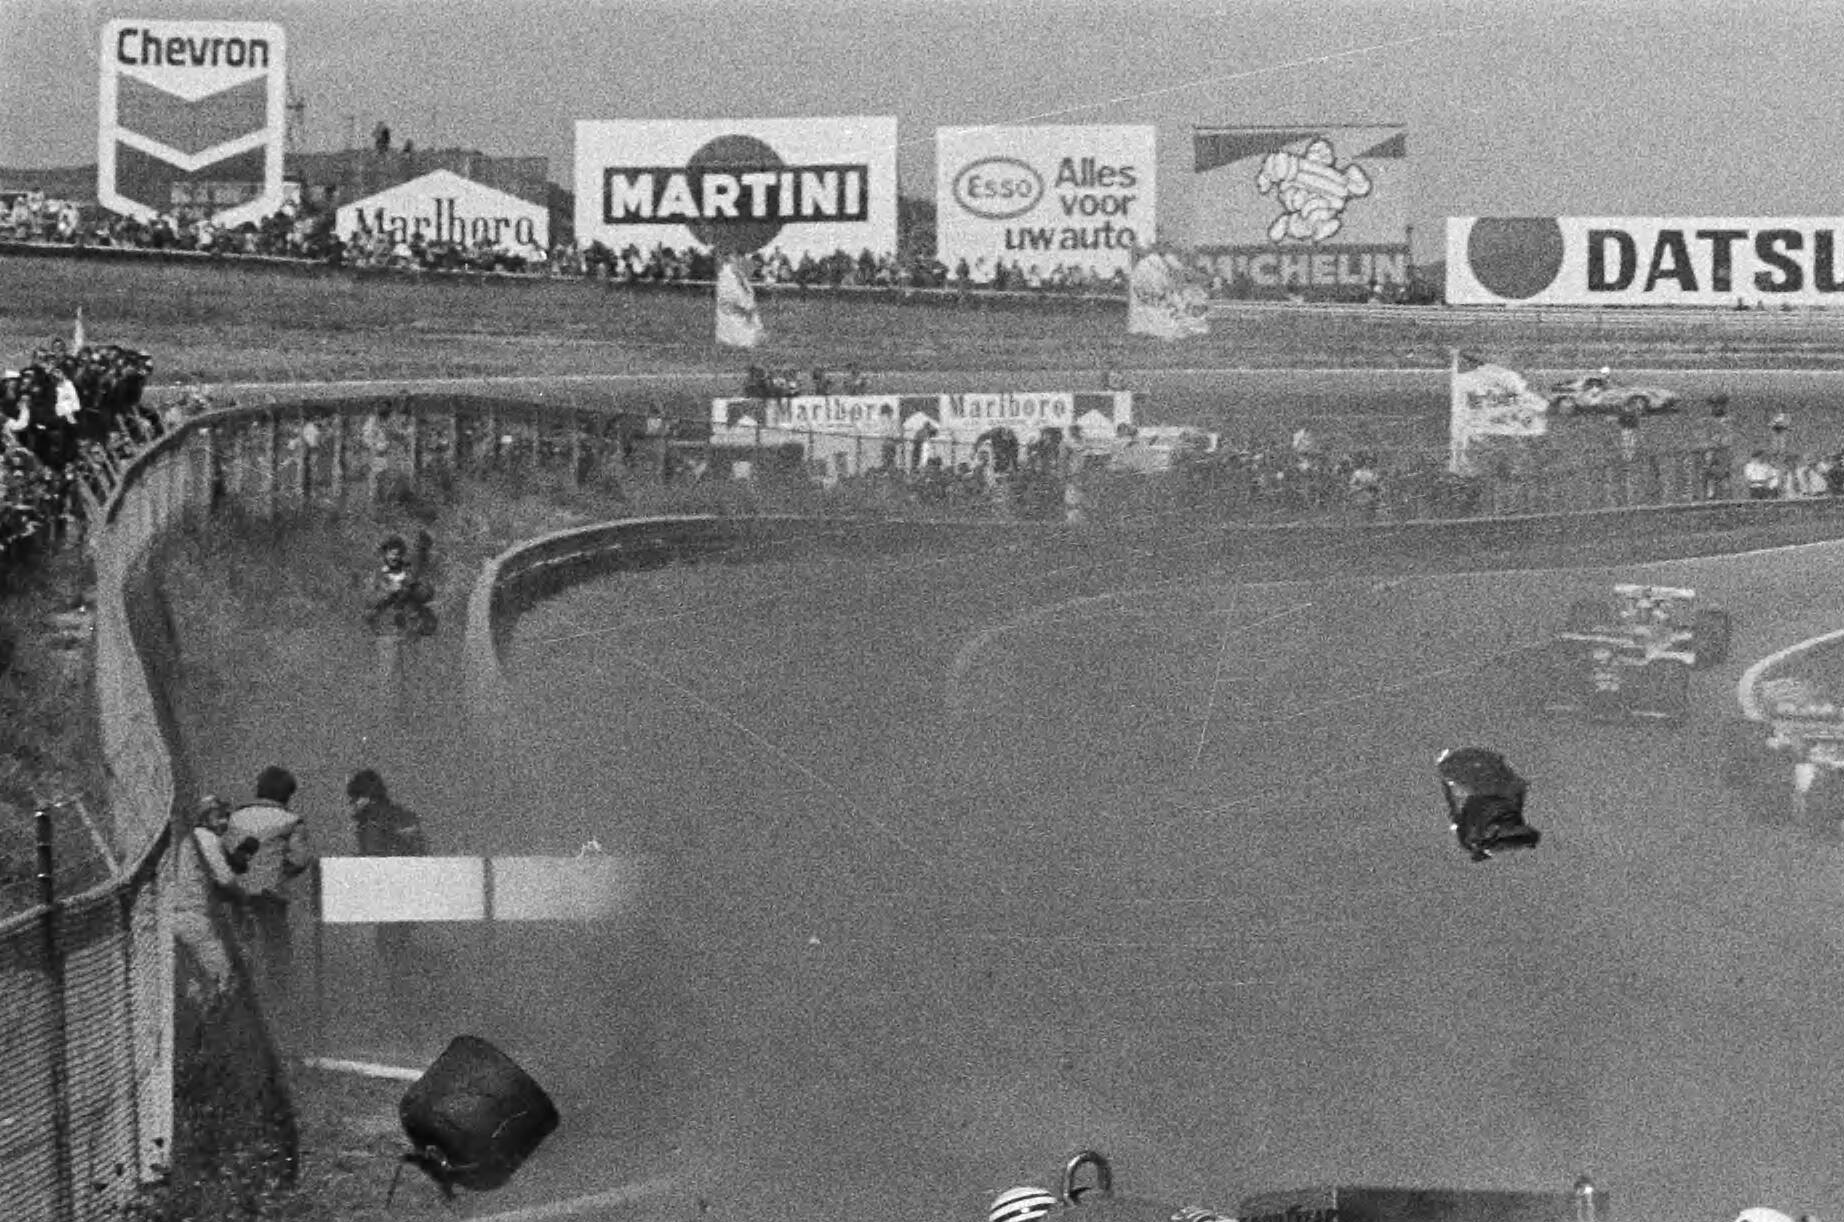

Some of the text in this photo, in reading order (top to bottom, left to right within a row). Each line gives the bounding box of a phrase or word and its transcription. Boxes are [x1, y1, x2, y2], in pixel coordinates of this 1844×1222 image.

[117, 28, 269, 67] Chevron
[967, 175, 1032, 198] Esso
[1054, 157, 1136, 187] Alles
[611, 170, 860, 218] MARTINI
[1060, 193, 1136, 217] voor
[355, 199, 536, 247] Marlboro
[1005, 221, 1138, 250] uw auto
[771, 399, 895, 424] Marlbor
